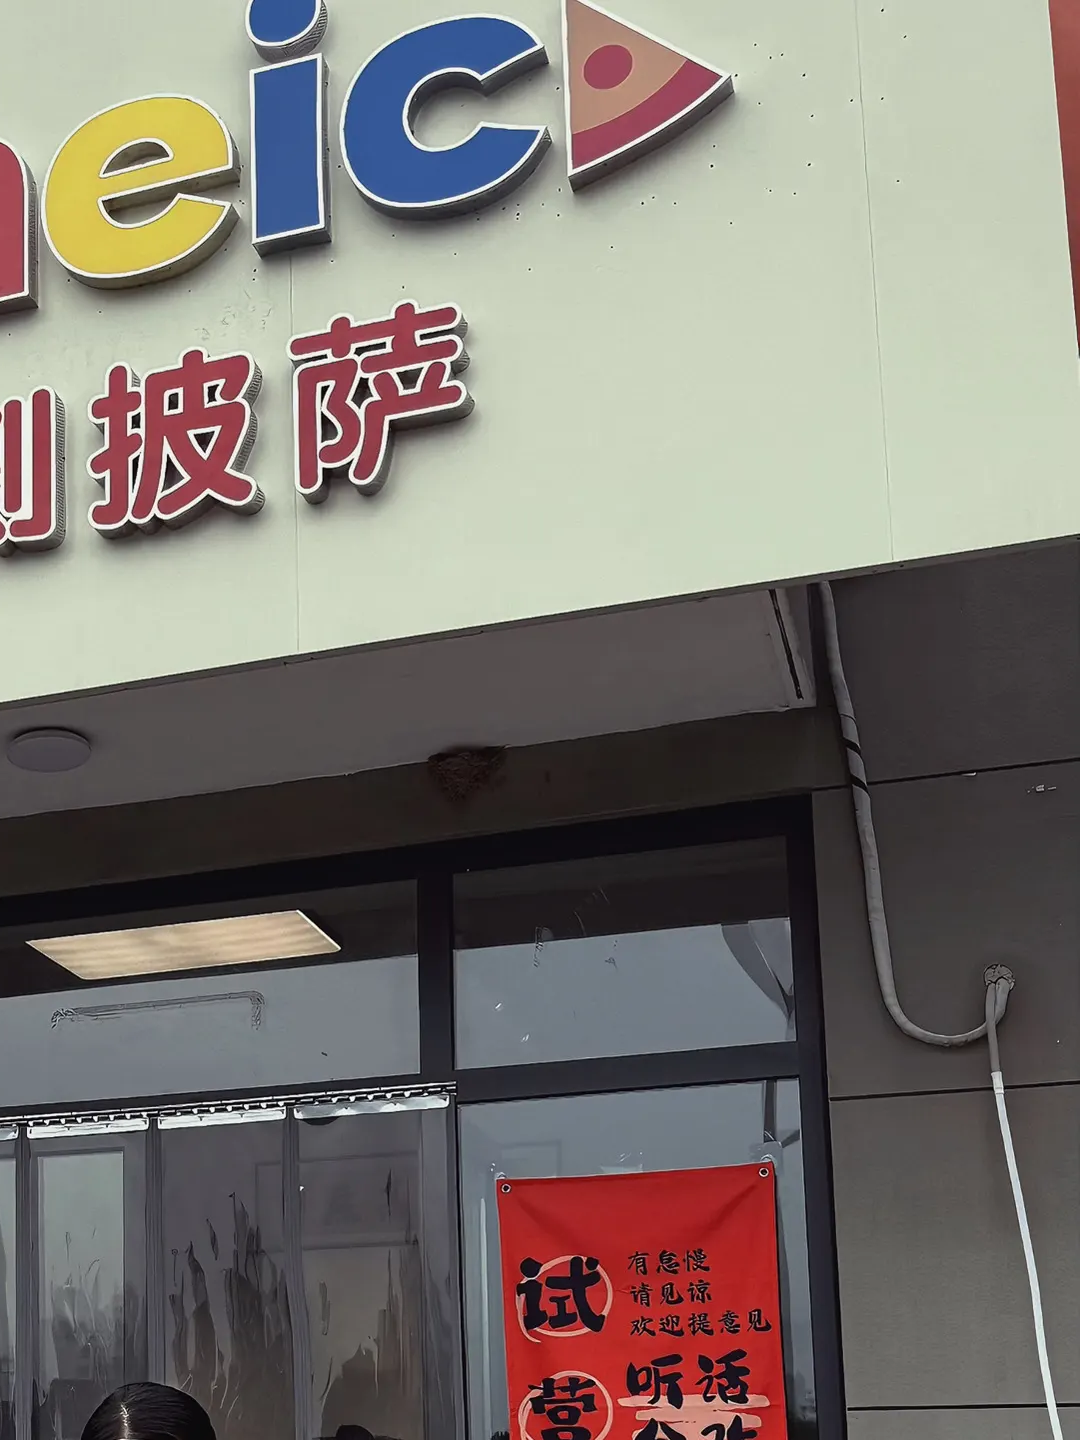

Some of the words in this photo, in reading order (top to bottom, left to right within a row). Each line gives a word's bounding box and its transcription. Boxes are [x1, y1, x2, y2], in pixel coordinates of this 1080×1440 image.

[627, 1248, 710, 1276] 有怠慢
[630, 1279, 712, 1307] 请见谅
[629, 1308, 772, 1337] 欢迎提意见
[626, 1348, 749, 1408] 听话
